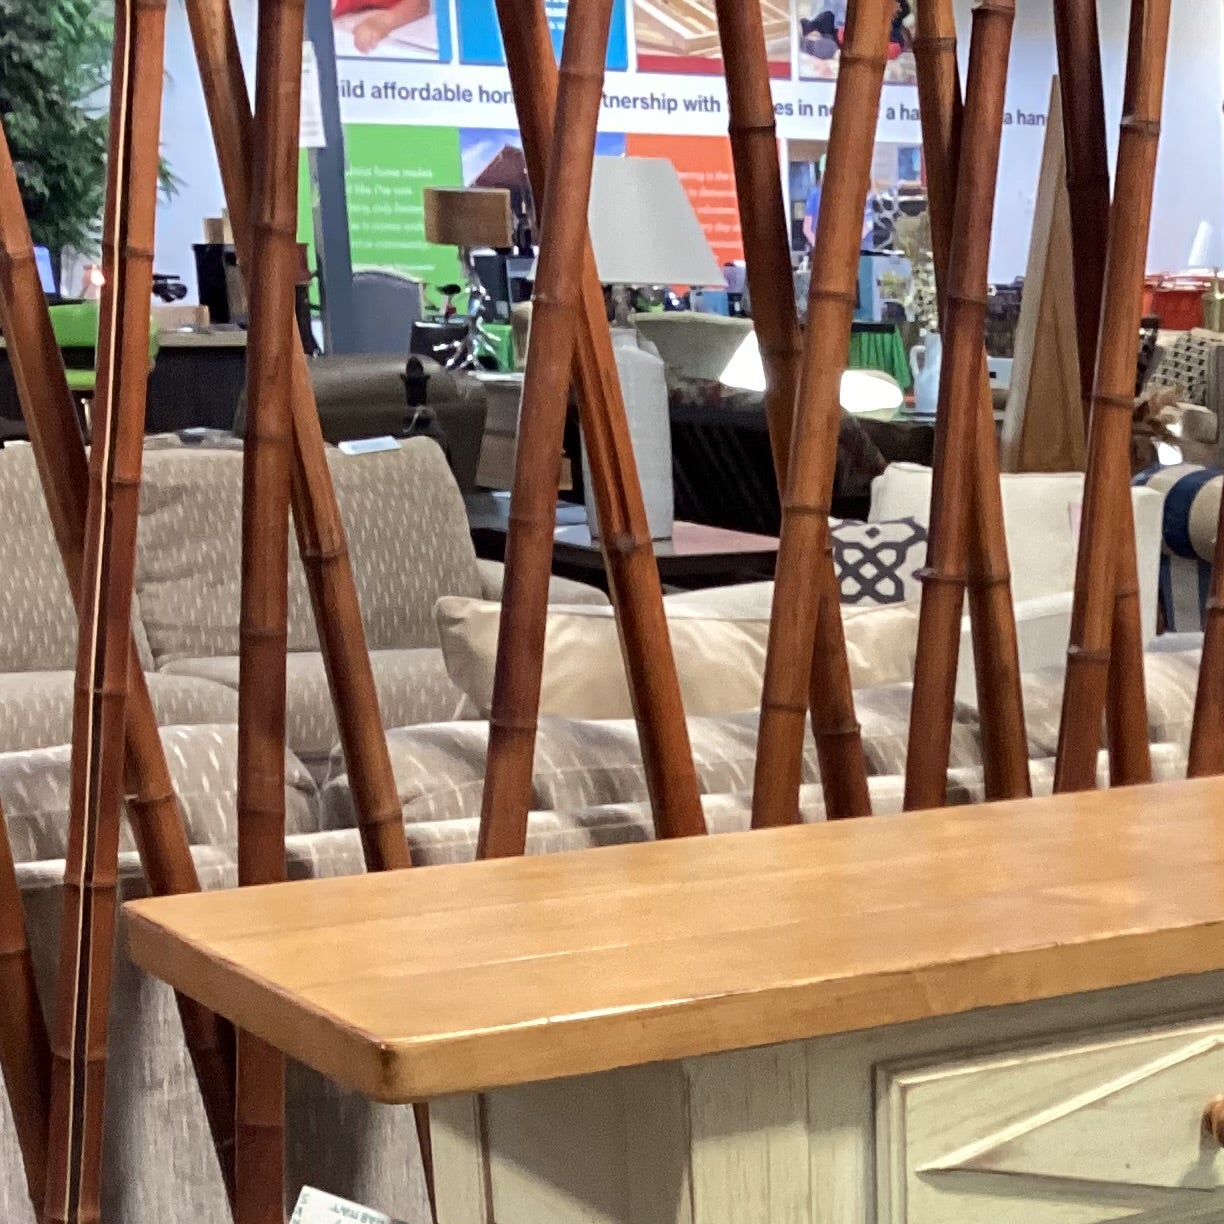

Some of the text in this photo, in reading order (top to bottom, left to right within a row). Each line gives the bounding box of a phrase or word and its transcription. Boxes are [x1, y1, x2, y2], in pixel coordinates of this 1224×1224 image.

[340, 79, 365, 98] ild
[370, 81, 473, 103] affordable
[602, 92, 678, 114] tnership
[683, 94, 721, 113] with
[798, 99, 813, 116] in
[886, 107, 896, 120] a
